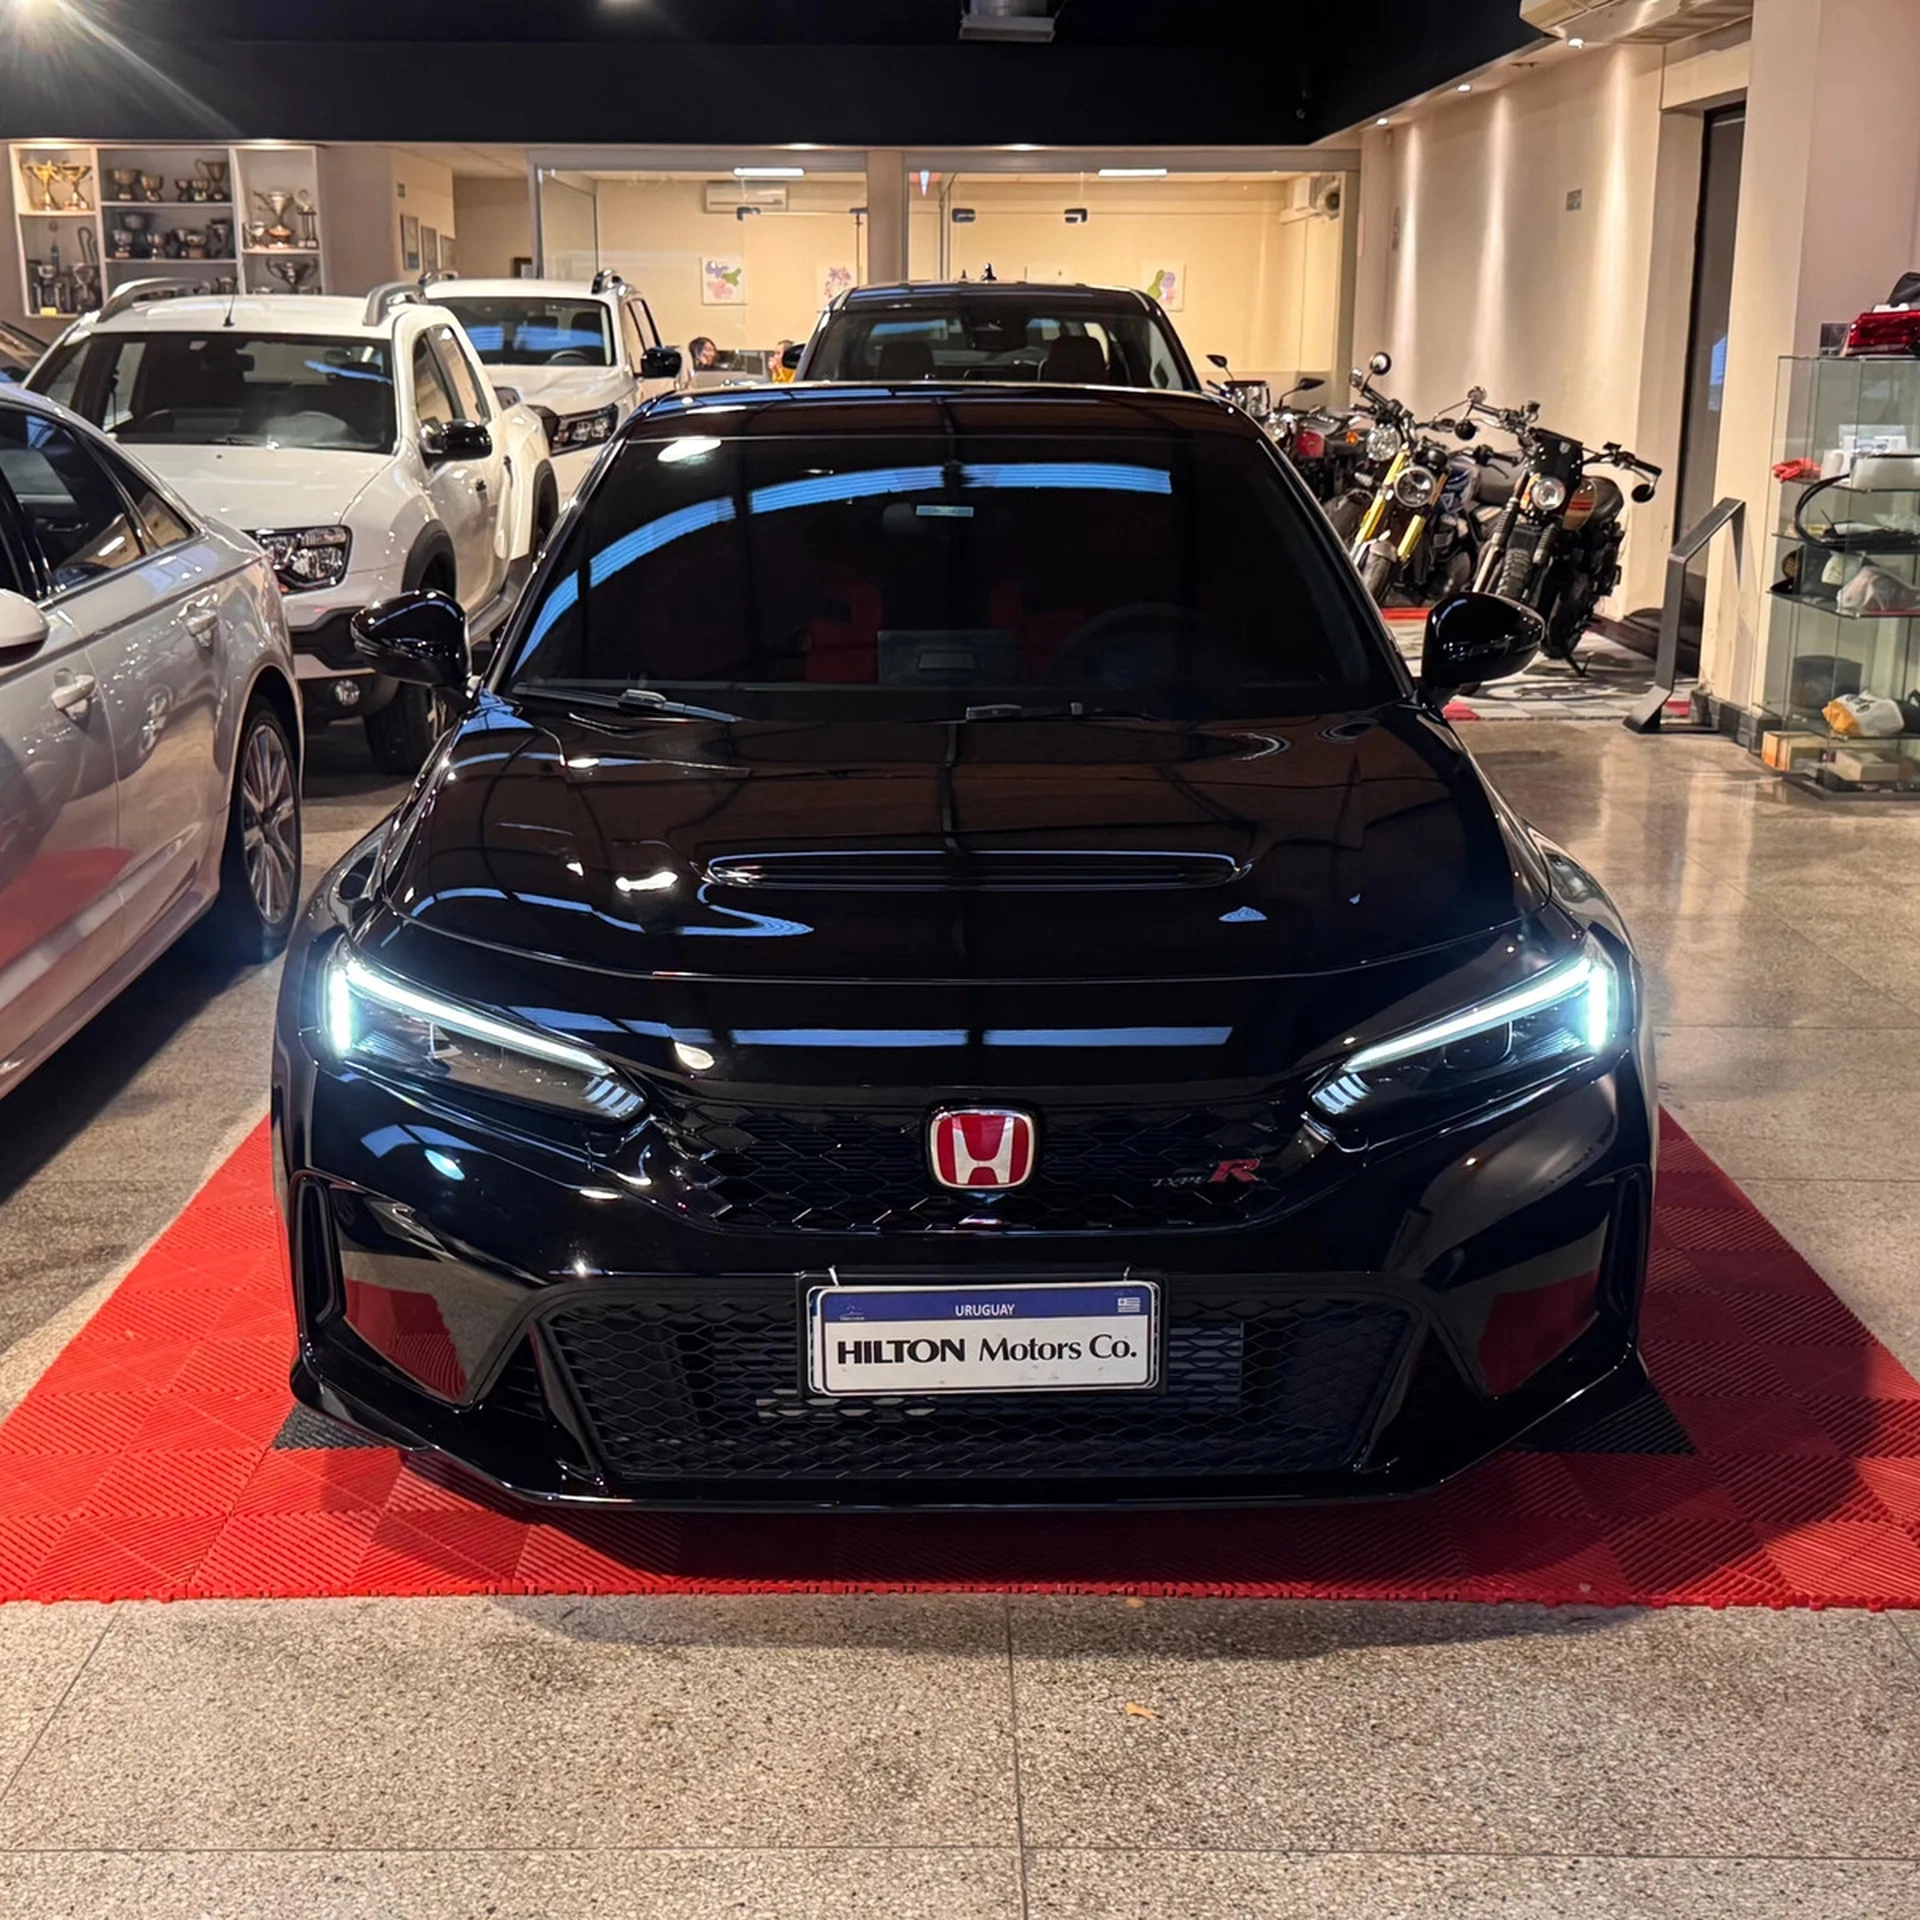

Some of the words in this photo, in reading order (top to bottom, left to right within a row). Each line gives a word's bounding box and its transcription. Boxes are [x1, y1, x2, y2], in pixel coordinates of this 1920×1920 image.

[952, 1115, 1014, 1184] H
[1208, 1158, 1261, 1183] R
[954, 1304, 1015, 1317] URUGUAY
[837, 1338, 966, 1364] HILTON
[978, 1337, 1082, 1362] Motors
[1089, 1334, 1138, 1359] Co.
